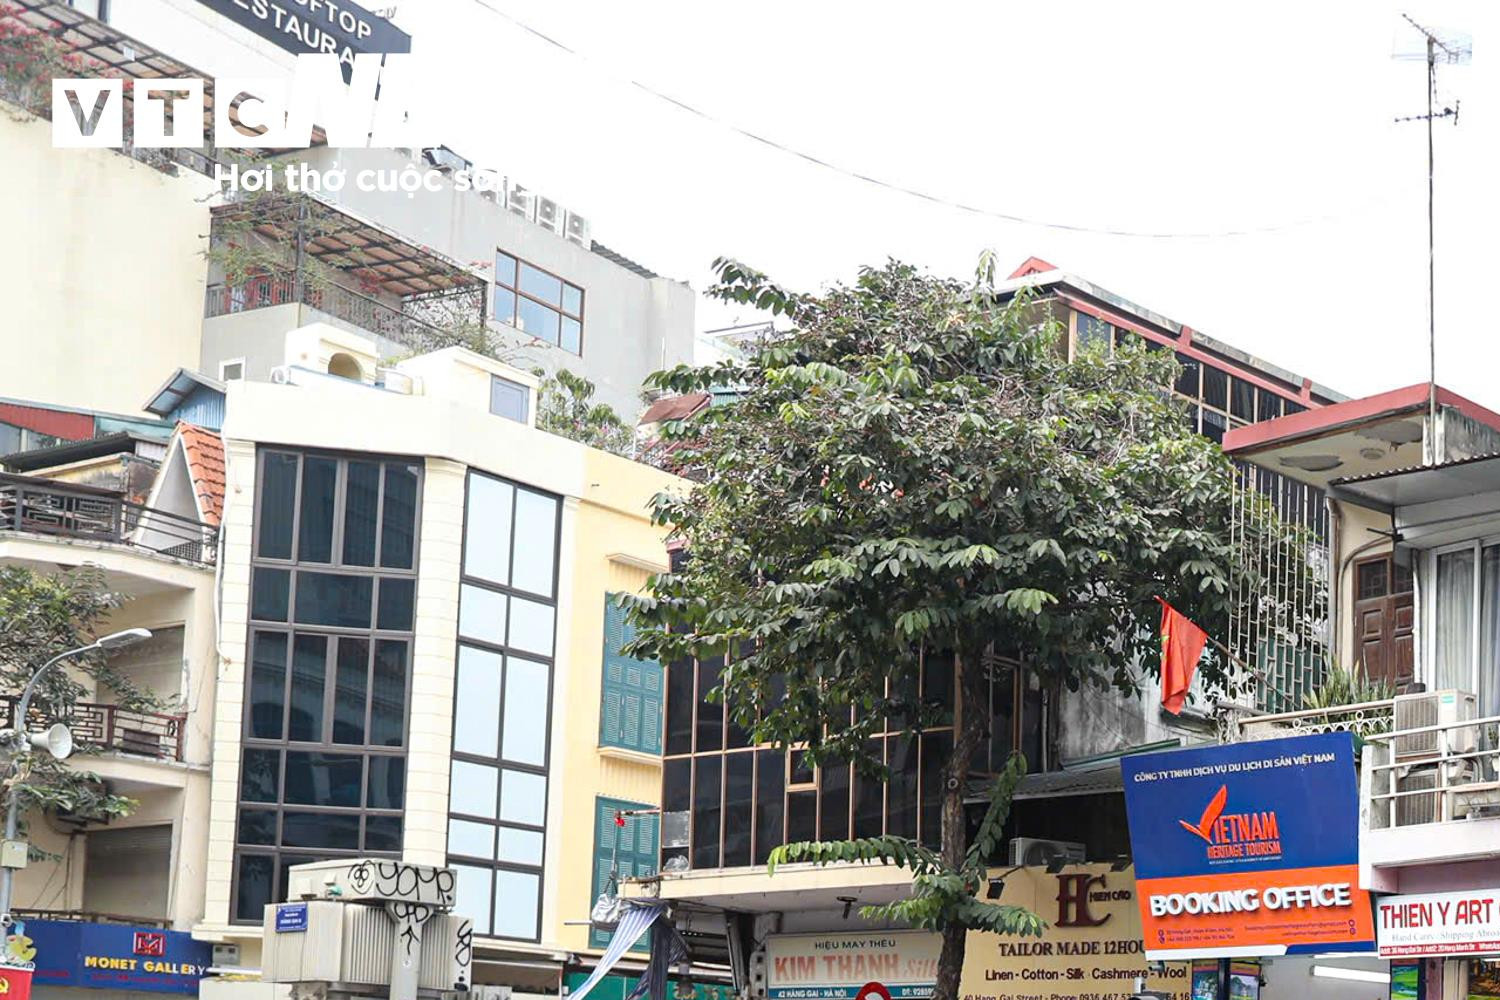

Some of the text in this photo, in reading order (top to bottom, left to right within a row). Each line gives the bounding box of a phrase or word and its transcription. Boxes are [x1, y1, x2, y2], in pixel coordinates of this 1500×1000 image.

[297, 0, 372, 39] FTOP
[1314, 752, 1336, 764] NAM
[1149, 882, 1353, 917] BOOKING OFFICE
[1380, 902, 1433, 929] THIEN
[1437, 901, 1451, 927] Y
[1455, 897, 1494, 926] ART
[842, 940, 866, 949] MAY
[1440, 929, 1475, 943] Shipping
[999, 942, 1053, 957] TAILOR
[1057, 941, 1100, 956] MADE
[84, 956, 206, 976] MONET GALLERY
[775, 955, 816, 981] KIM
[822, 953, 899, 980] THANH
[985, 969, 1014, 981] Linen
[1021, 968, 1059, 981] Cotton
[1066, 968, 1085, 980] Silk
[1092, 967, 1149, 980] Cashmere
[1158, 966, 1187, 978] Wool
